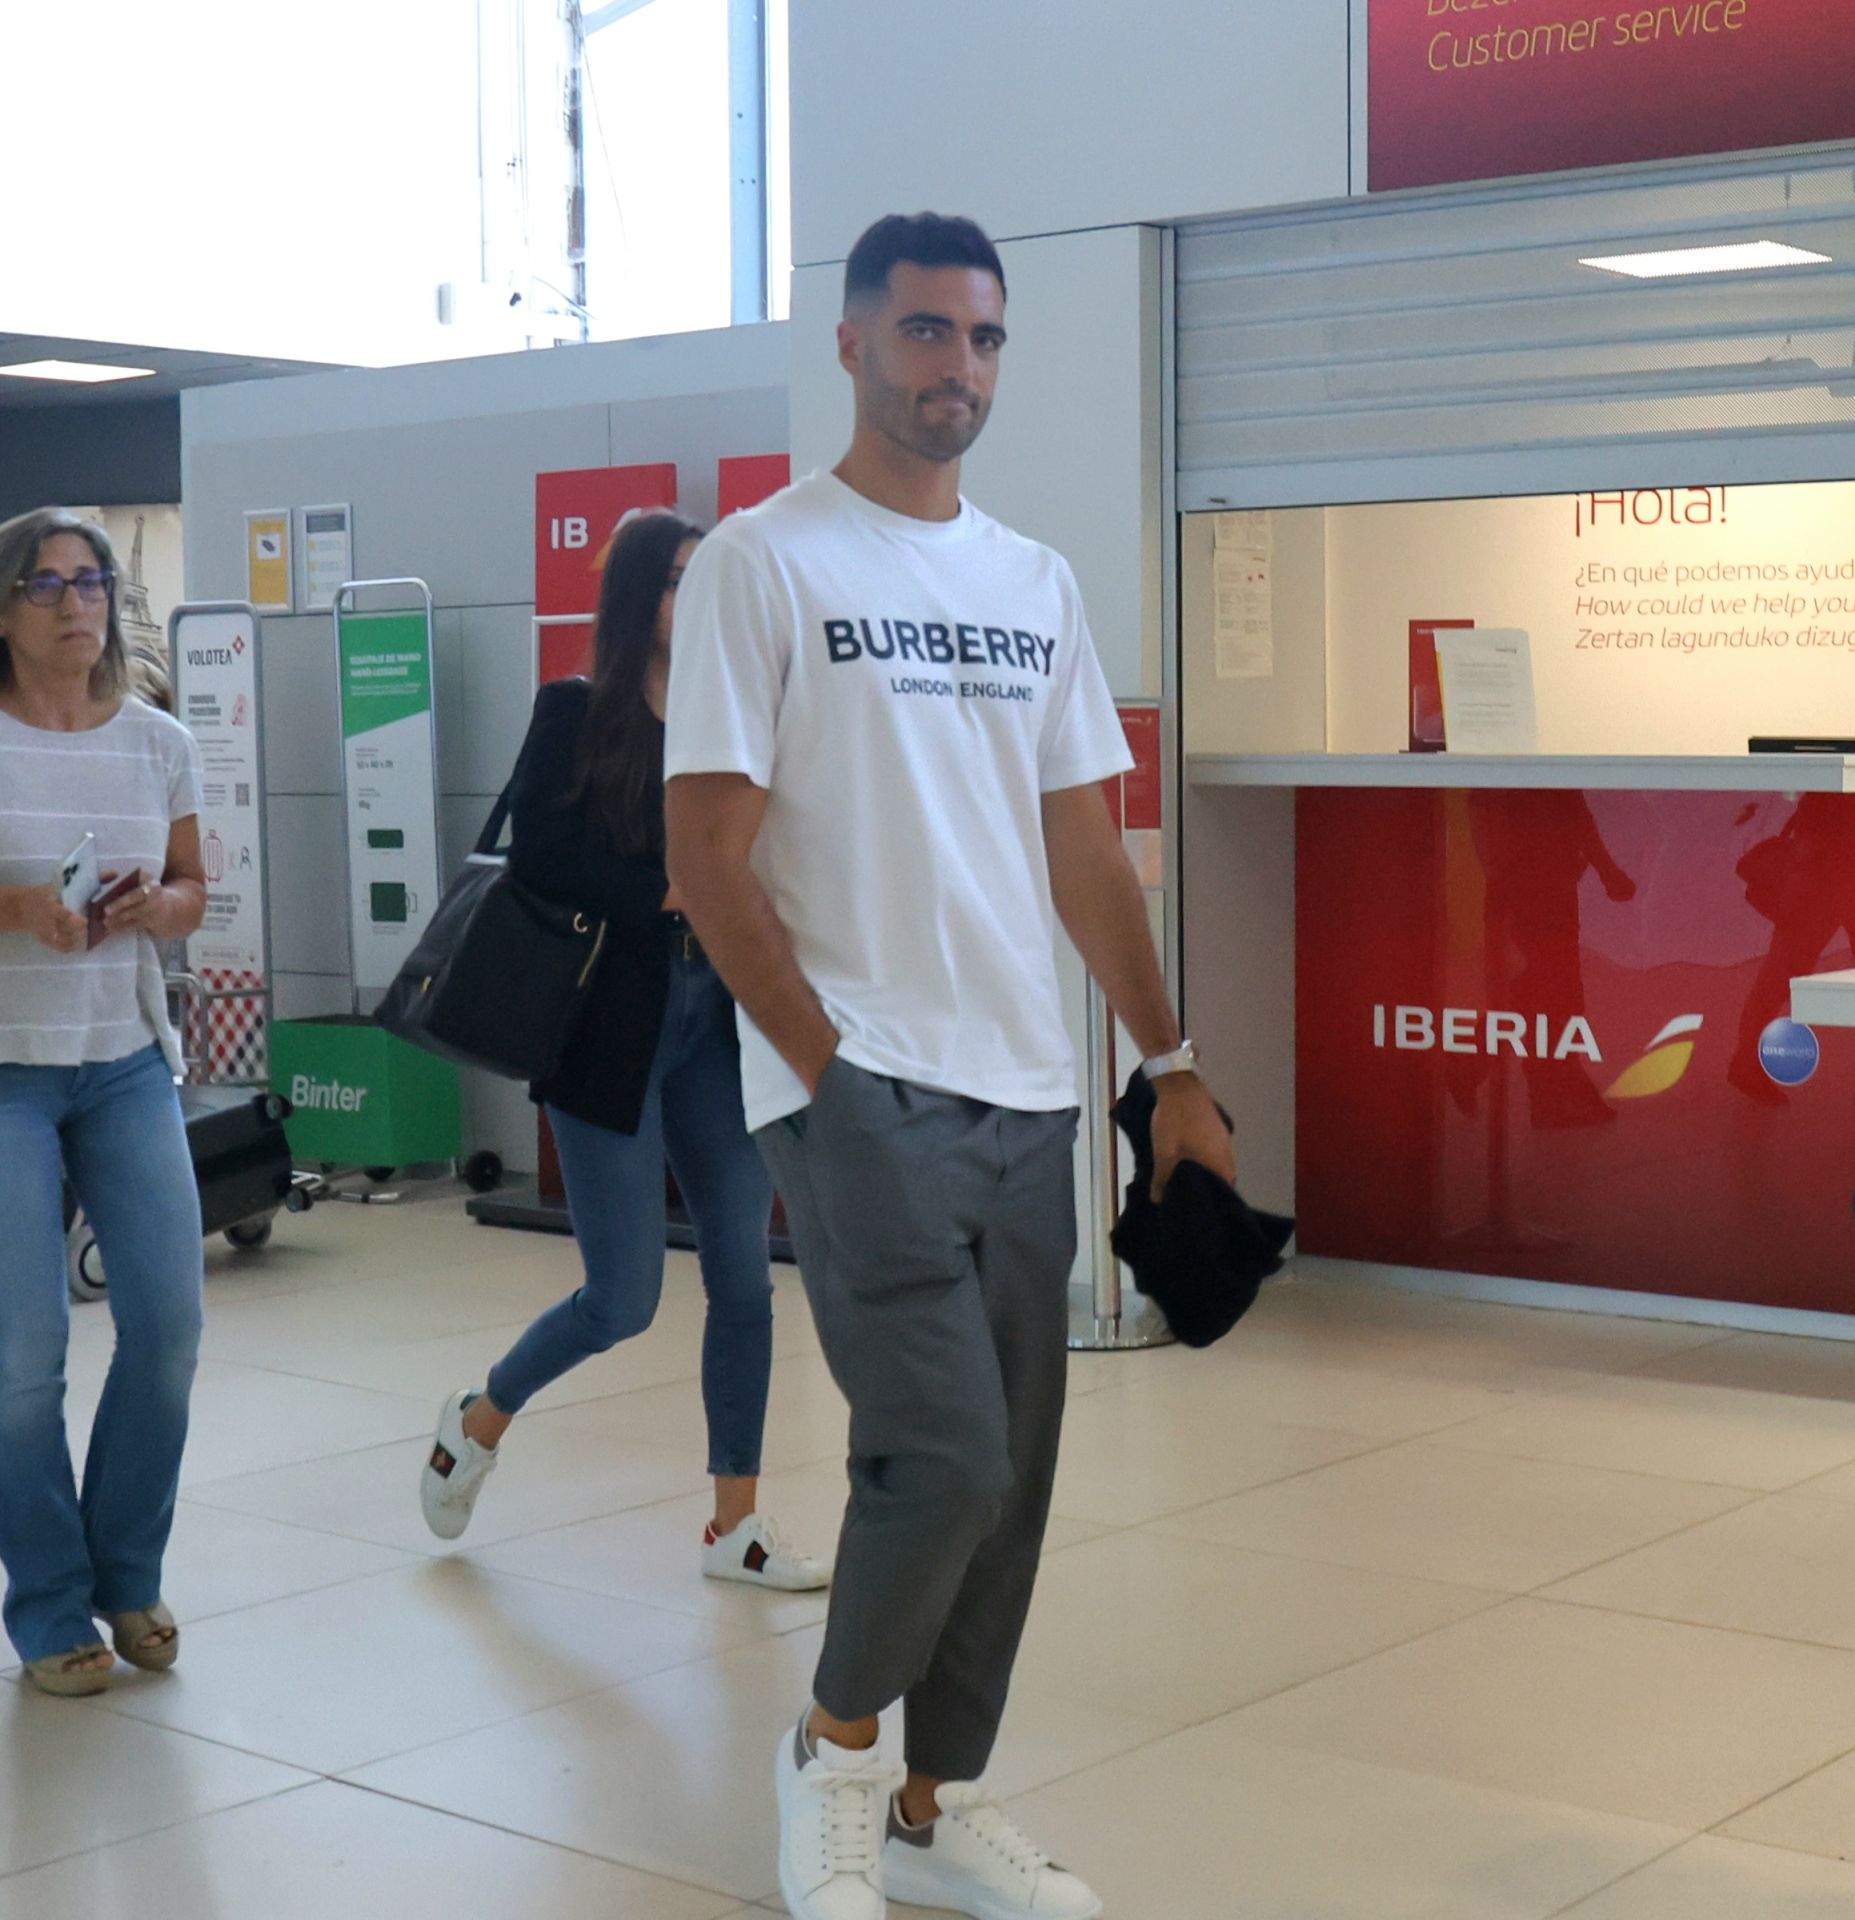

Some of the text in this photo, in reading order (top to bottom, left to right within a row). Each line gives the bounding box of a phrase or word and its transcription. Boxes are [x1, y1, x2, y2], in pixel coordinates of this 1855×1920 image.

[1428, 0, 1746, 71] Customer service
[1575, 562, 1617, 588] ¿En
[1623, 560, 1669, 588] qué
[1676, 560, 1789, 587] podemos
[1575, 592, 1855, 619] How could we help you
[823, 618, 1055, 677] BURBERRY
[1575, 627, 1655, 650] Zertan
[1661, 626, 1789, 654] lagunduko
[187, 648, 233, 666] VOLOTEA
[890, 678, 953, 696] LONDON
[1373, 1004, 1602, 1062] IBERIA
[291, 1074, 368, 1112] Binter
